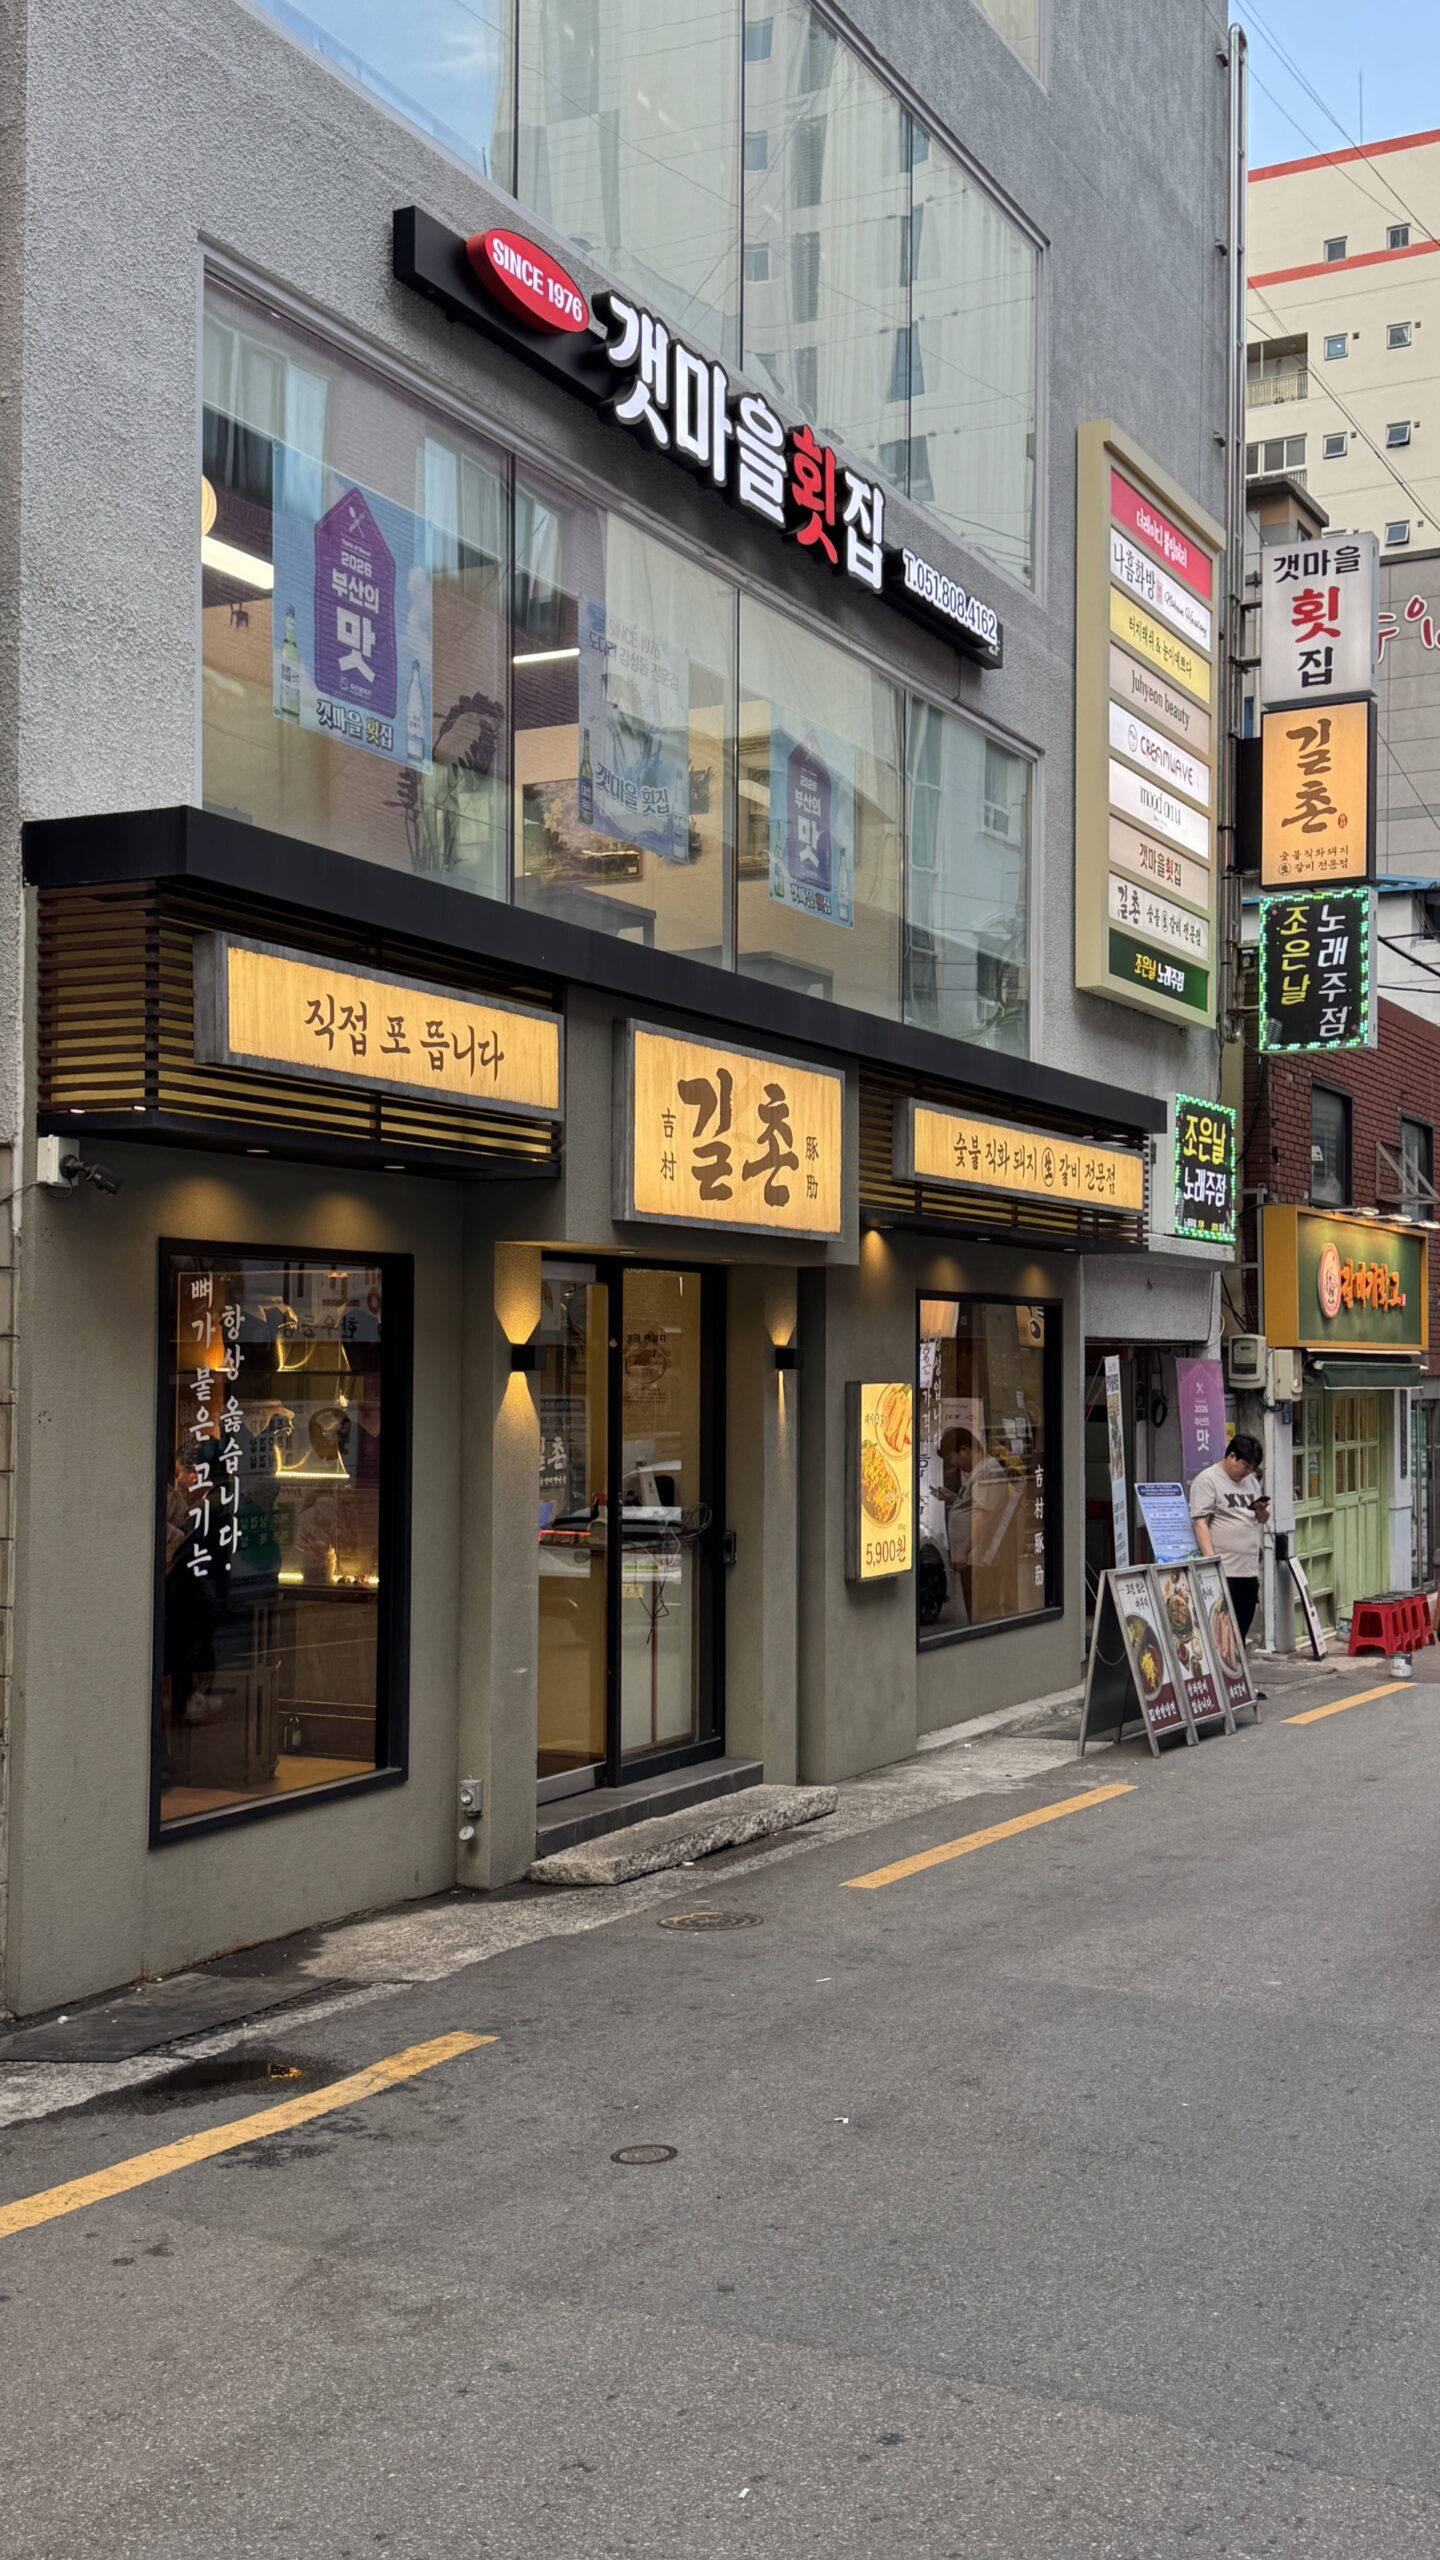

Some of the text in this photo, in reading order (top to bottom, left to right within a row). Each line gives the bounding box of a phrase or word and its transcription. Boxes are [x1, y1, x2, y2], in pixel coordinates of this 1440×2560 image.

[491, 238, 583, 322] SINCE 1976
[607, 296, 884, 592] 갯마을횟집
[331, 569, 379, 614] 부산의
[341, 553, 372, 578] 2026
[1113, 542, 1156, 601] 나흠화방
[1273, 545, 1362, 584] 갯마을
[903, 549, 998, 643] T.051.808.4162
[336, 607, 377, 683] 맛
[588, 630, 618, 657] 도다리
[608, 618, 661, 660] SINCE 1976
[1291, 584, 1342, 690] 횟집
[316, 698, 364, 738] 갯마을
[365, 717, 394, 751] 횟집
[1131, 669, 1191, 731] Juhyeon beauty
[595, 762, 639, 811] 갯마을
[640, 785, 671, 818] 횟집
[794, 789, 822, 817] 부산의
[799, 773, 818, 792] 2026
[1280, 718, 1338, 834] 길촌
[797, 815, 825, 871] 맛
[1138, 842, 1182, 888] 갯마을횟집
[1294, 860, 1315, 875] 갈비
[1317, 858, 1350, 873] 전문점
[1117, 883, 1141, 926] 길촌
[1134, 953, 1185, 993] 조은날 노래주점
[1279, 902, 1352, 1039] 조은날 노래주점
[304, 993, 506, 1083] 직접 포 뜹니다
[660, 1107, 677, 1182] 吉村
[677, 1067, 800, 1208] 길촌
[953, 1132, 982, 1171] 숯불
[985, 1138, 1010, 1175] 직화
[1013, 1147, 1037, 1181] 돼지
[1058, 1154, 1081, 1189] 갈비
[1084, 1159, 1117, 1196] 전문점
[1183, 1113, 1227, 1166] 조은날
[1183, 1166, 1226, 1209] 노래주점
[187, 1272, 216, 1577] 뼈가 붙은 고기는
[1194, 1404, 1209, 1414] 2026
[218, 1303, 246, 1572] 항상 옳습니다.
[1196, 1429, 1210, 1452] 맛
[865, 1534, 907, 1569] 5,900원
